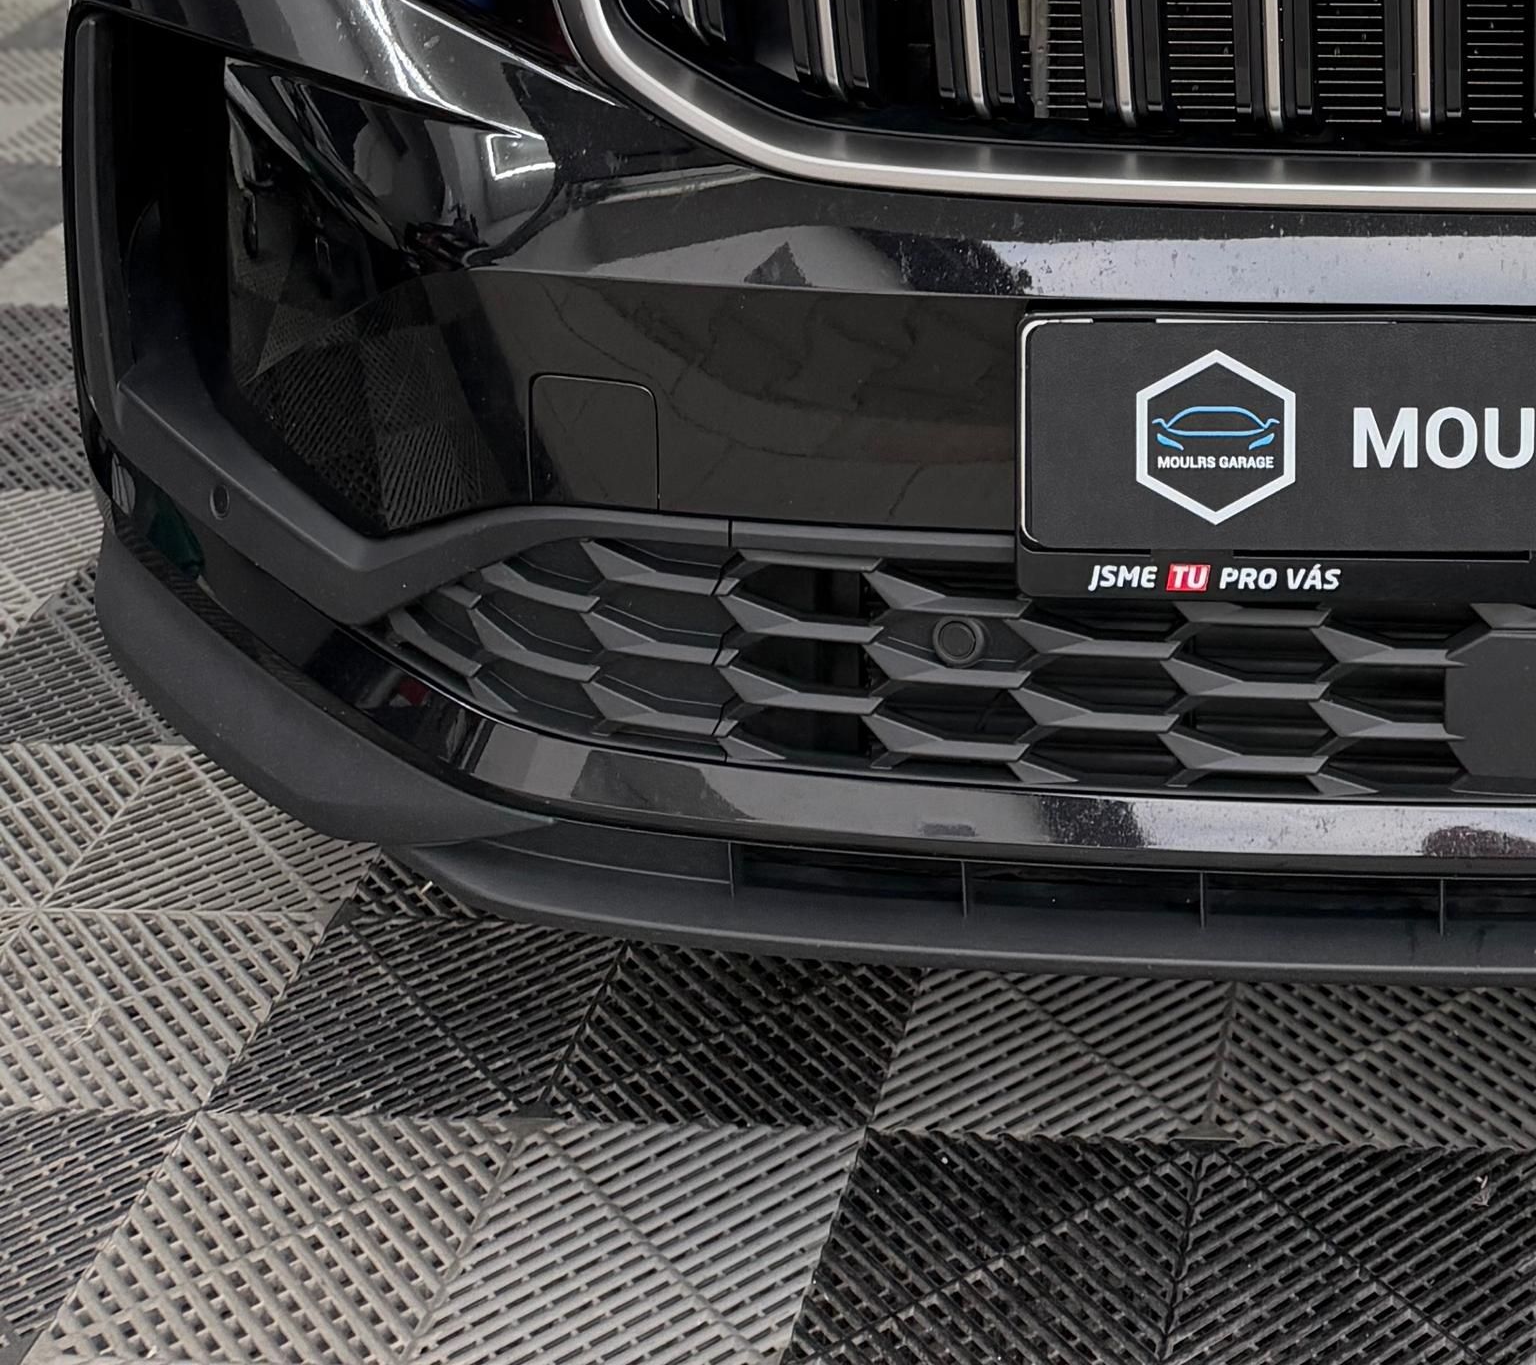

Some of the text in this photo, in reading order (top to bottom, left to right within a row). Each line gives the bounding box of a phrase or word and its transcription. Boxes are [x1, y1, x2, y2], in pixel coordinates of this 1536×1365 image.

[1157, 455, 1274, 469] MOULRS GARAGE
[1089, 563, 1341, 591] JSME TU PRO VÁS
